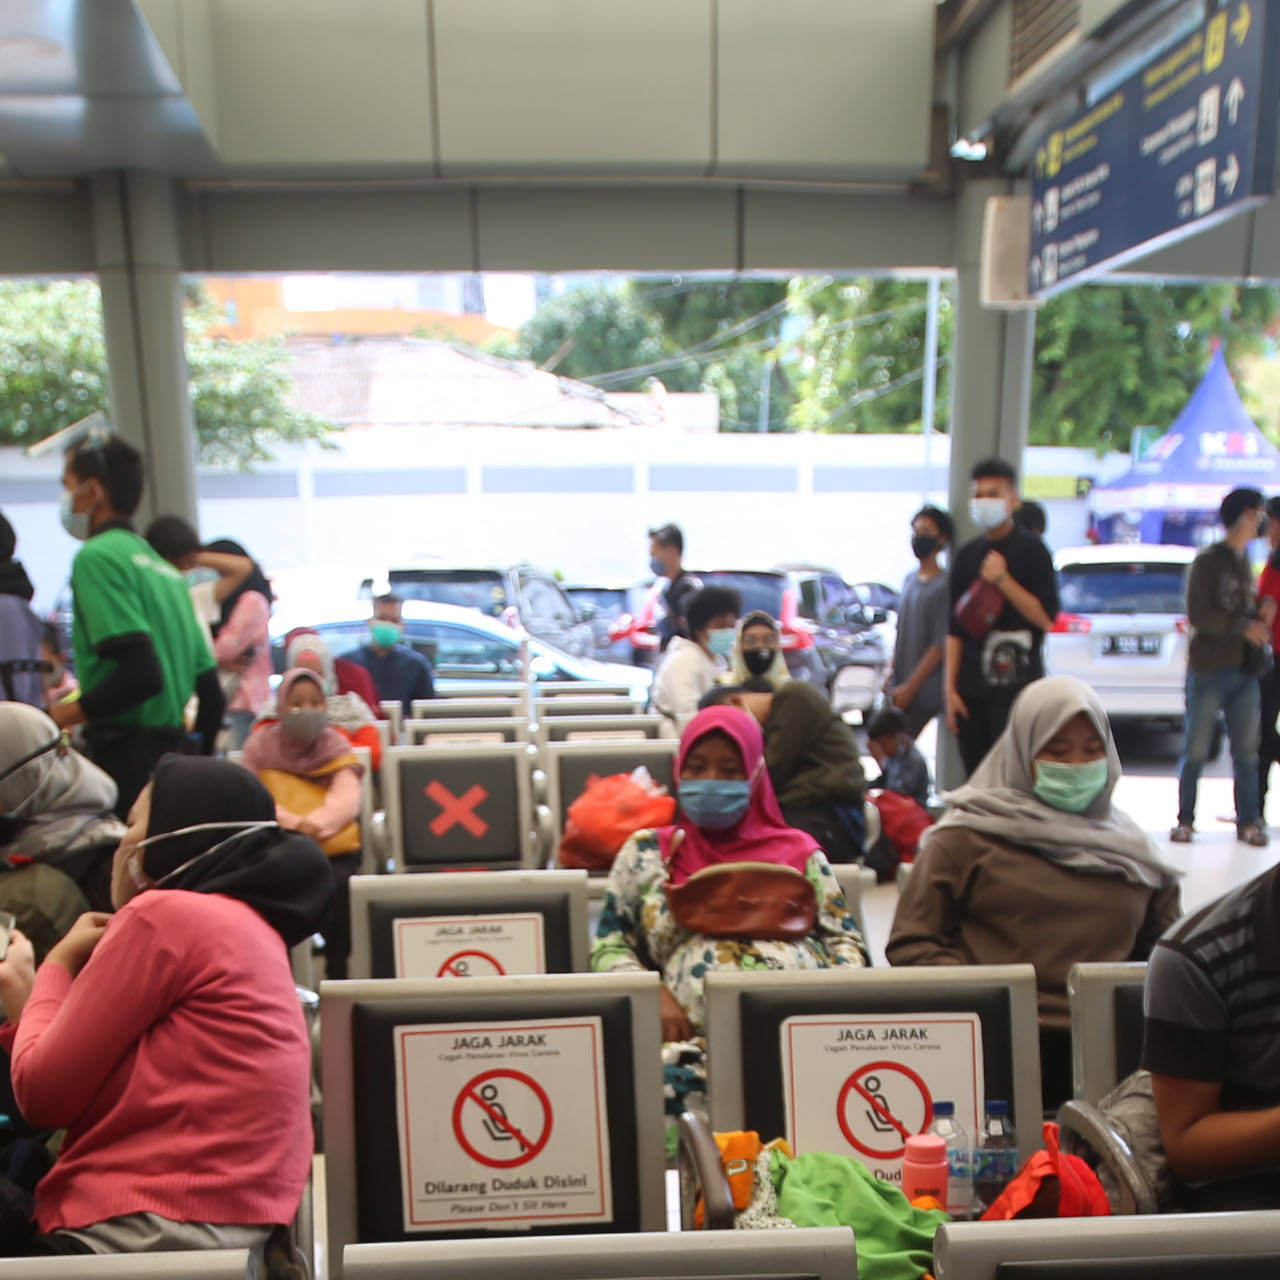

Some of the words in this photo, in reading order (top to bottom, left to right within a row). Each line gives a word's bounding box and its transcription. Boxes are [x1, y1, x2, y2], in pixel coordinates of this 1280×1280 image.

[837, 1029, 876, 1041] JAGA
[882, 1029, 927, 1040] JARAK
[452, 1037, 492, 1050] JAGA
[498, 1035, 546, 1048] JARAK
[875, 1169, 901, 1181] Dud
[425, 1182, 486, 1195] Dilarang
[492, 1178, 538, 1191] Duduk
[544, 1175, 587, 1189] Disini
[451, 1203, 485, 1214] Please
